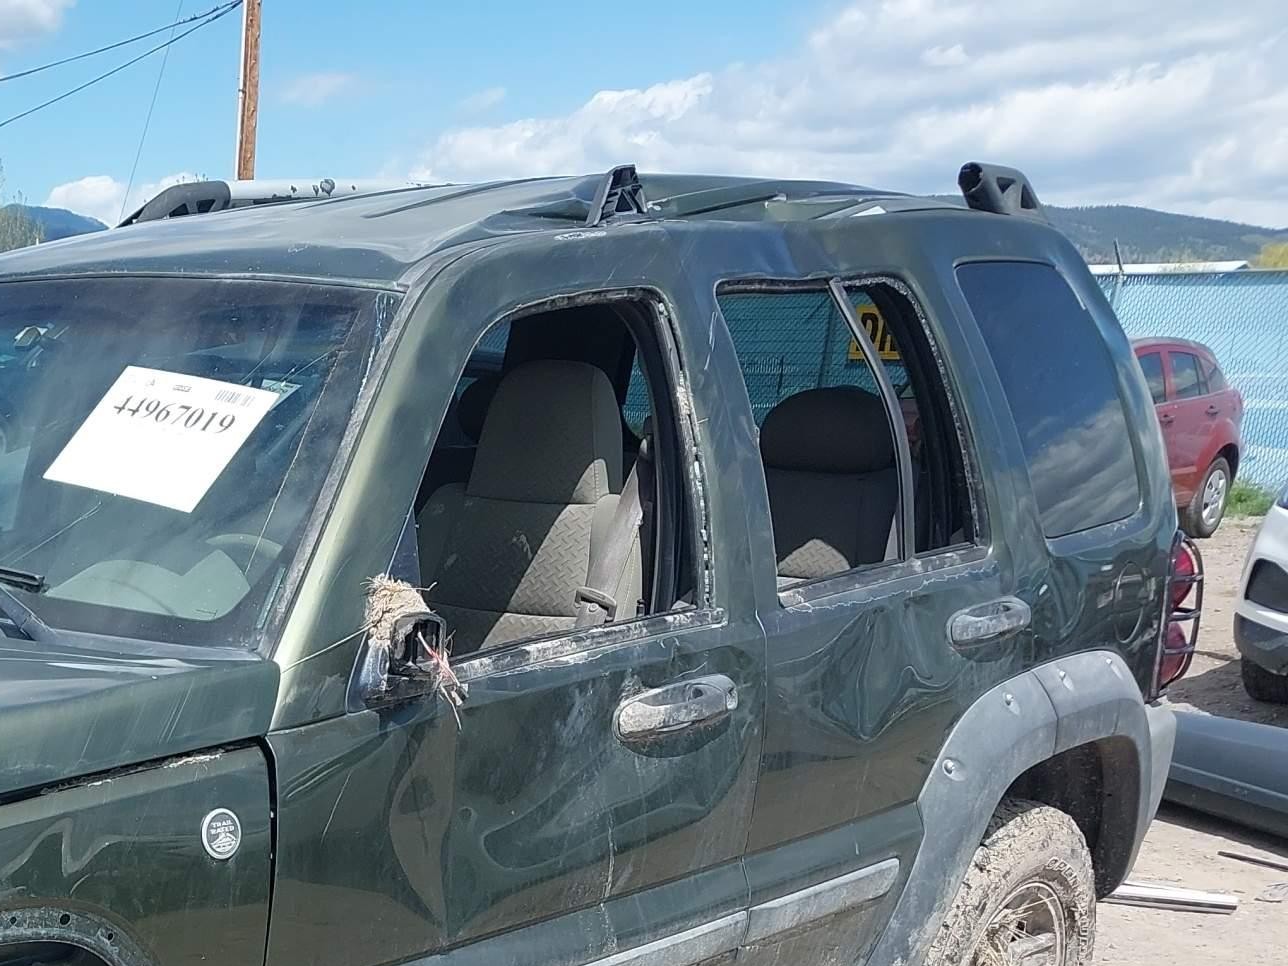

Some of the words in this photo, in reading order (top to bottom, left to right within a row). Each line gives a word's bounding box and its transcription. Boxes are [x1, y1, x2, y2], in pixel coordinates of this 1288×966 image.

[114, 395, 236, 434] 44967019
[210, 819, 234, 828] TRAIL
[209, 825, 235, 835] RATED
